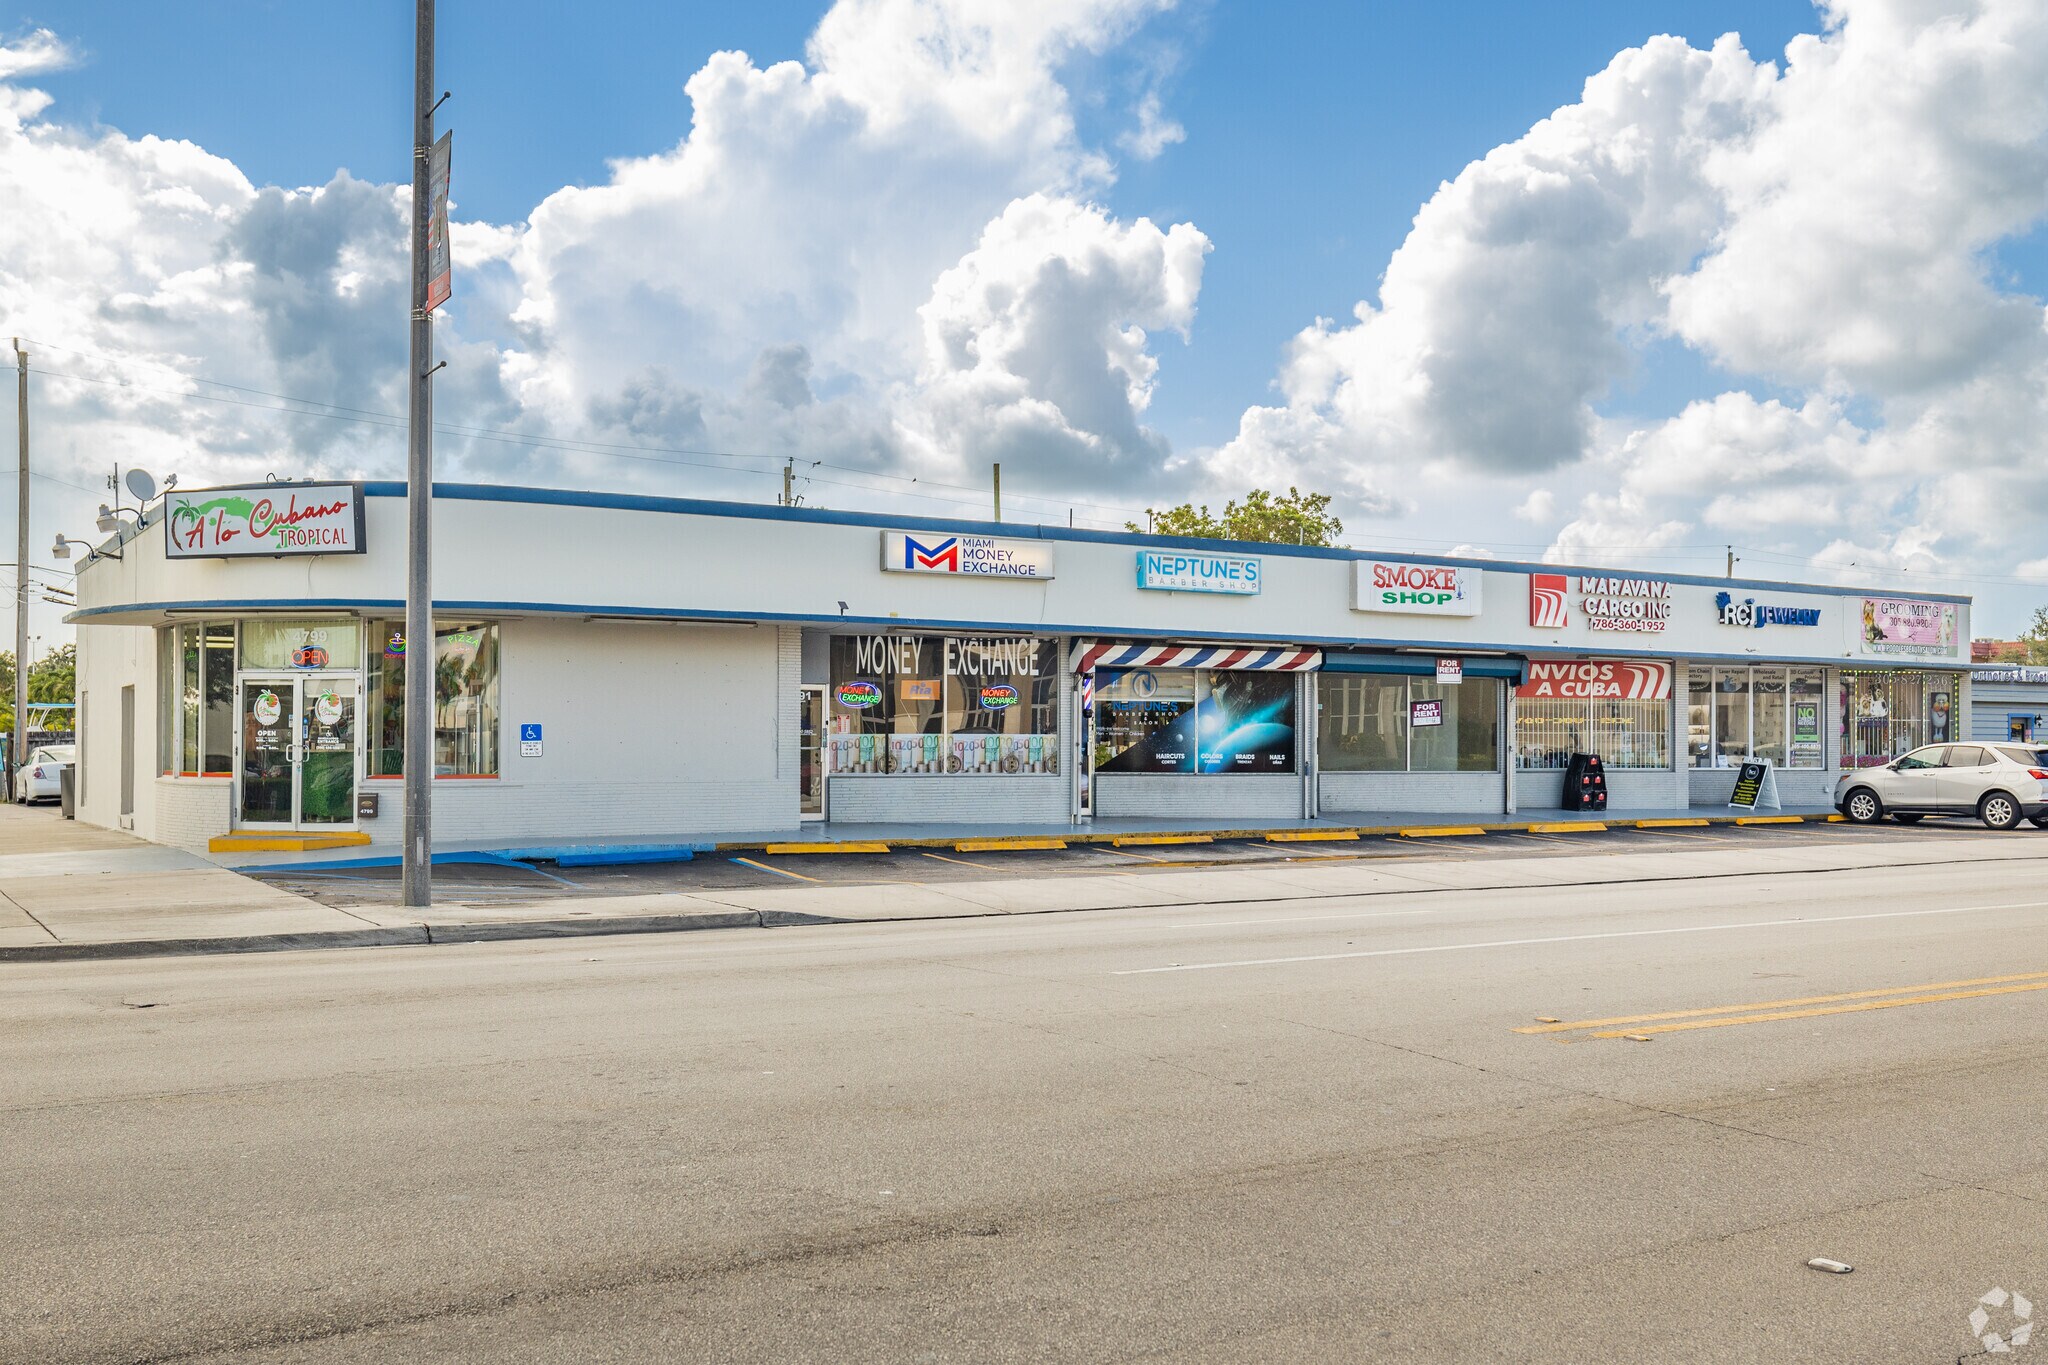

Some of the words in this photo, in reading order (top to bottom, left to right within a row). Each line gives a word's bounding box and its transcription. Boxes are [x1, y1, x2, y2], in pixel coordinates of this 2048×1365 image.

[185, 515, 205, 549] A
[249, 494, 348, 539] Cubano
[278, 527, 348, 546] TROPICAL
[962, 538, 994, 549] MIAMI
[962, 549, 1014, 561] MONEY
[963, 561, 1036, 576] EXCHANGE
[1148, 555, 1257, 581] NEPTUNE'S
[1148, 577, 1208, 588] BARBER
[1219, 581, 1257, 590] SHOP
[1373, 563, 1456, 591] SMOKE
[1579, 576, 1672, 599] MARAVANA
[1382, 592, 1452, 605] SHOP
[1583, 597, 1644, 618] CARGO
[1645, 601, 1671, 619] INC
[1880, 602, 1939, 618] GROOMING
[1754, 606, 1821, 628] JEWELRY
[1594, 618, 1665, 631] 786-360-1952
[293, 630, 328, 642] 4799
[447, 633, 479, 648] PIZZA
[291, 649, 329, 664] OPEN
[855, 635, 923, 675] MONEY
[946, 637, 1040, 676] EXCHANGE
[1441, 659, 1458, 667] FOR
[1439, 666, 1460, 674] RENT
[1529, 663, 1614, 680] NVIOS
[2025, 670, 2048, 683] Prost
[840, 685, 871, 695] MONEY
[981, 688, 1011, 697] MONEY
[1535, 681, 1553, 696] A
[1560, 682, 1622, 697] CUBA
[842, 694, 879, 703] EXCHANGE
[983, 696, 1018, 705] EXCHANGE
[1112, 701, 1179, 711] NEPTUNE'S
[1416, 703, 1436, 711] FOR
[1797, 707, 1815, 718] NO
[1413, 709, 1439, 717] RENT
